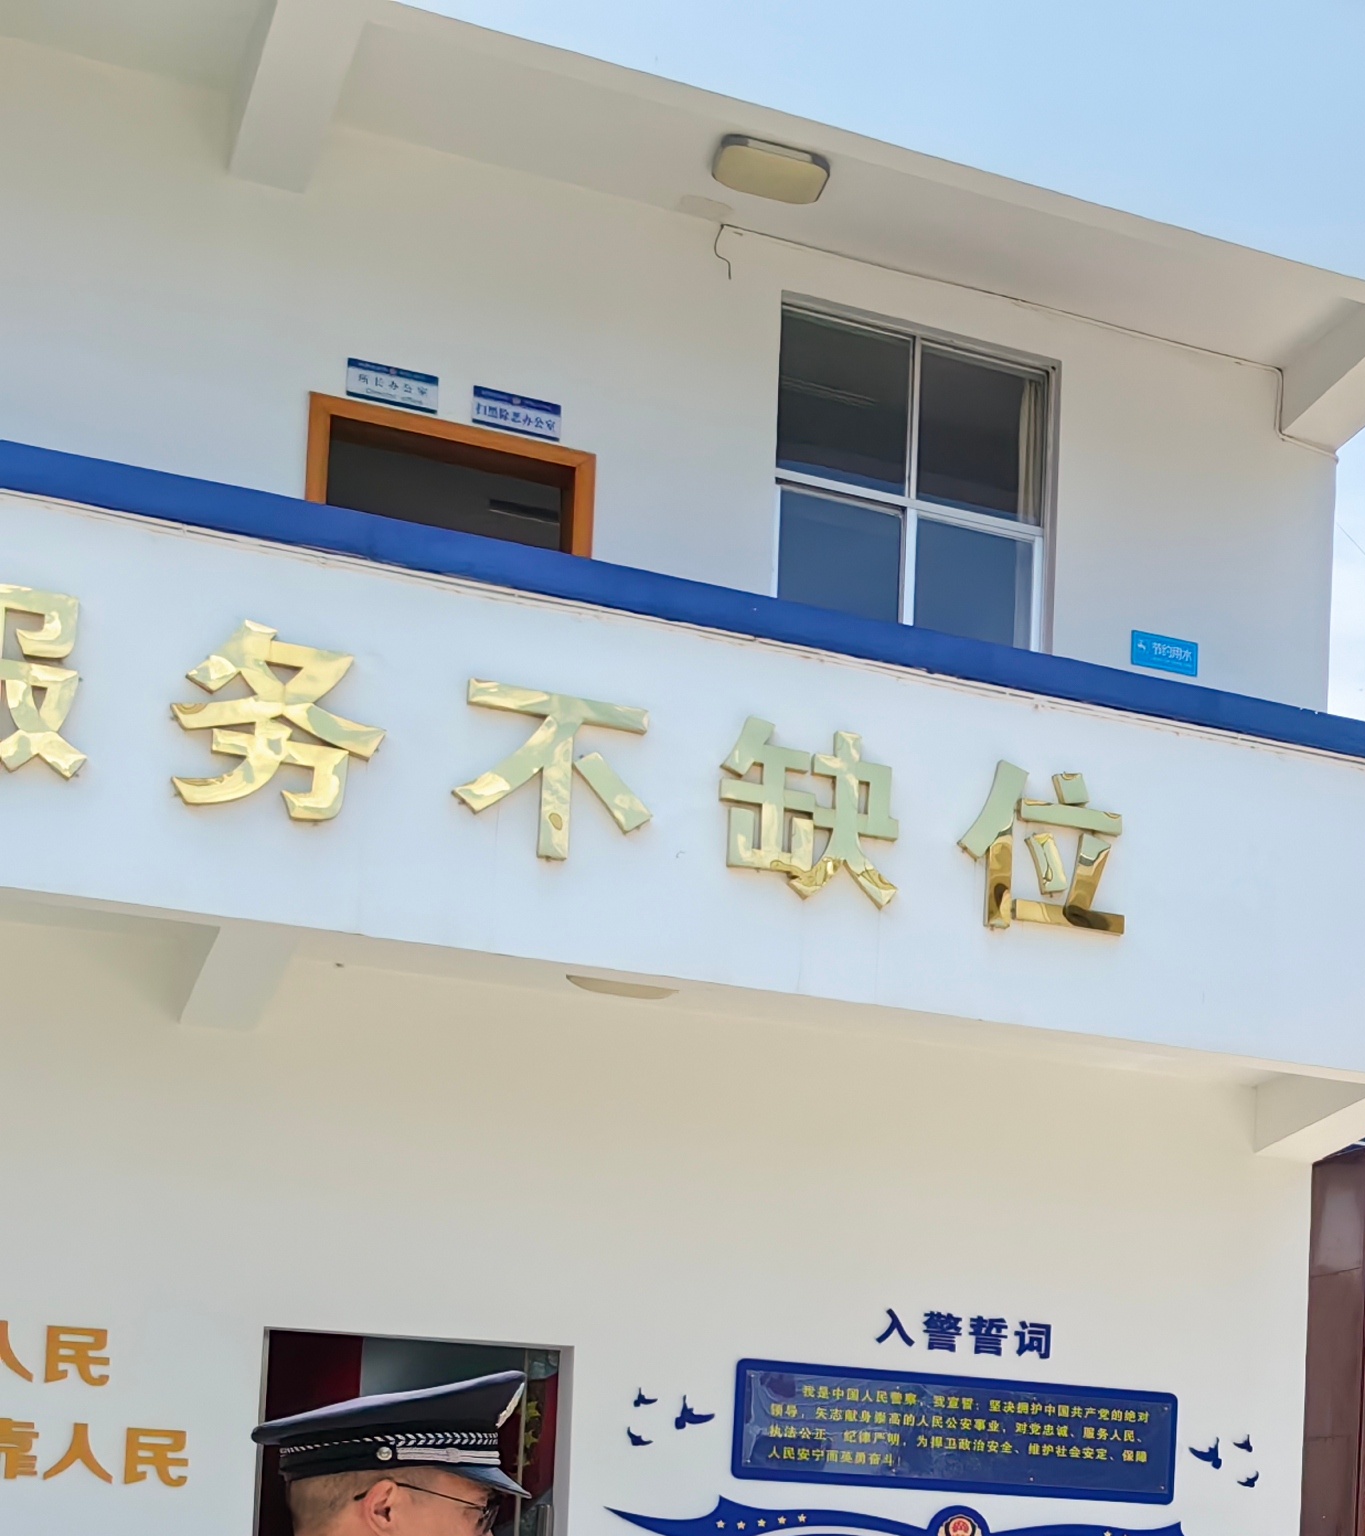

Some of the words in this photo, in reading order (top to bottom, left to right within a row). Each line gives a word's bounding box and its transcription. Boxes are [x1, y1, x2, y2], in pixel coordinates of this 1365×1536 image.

[476, 402, 556, 432] 扫黑除恶办公室
[876, 1308, 1053, 1359] 入警誓词
